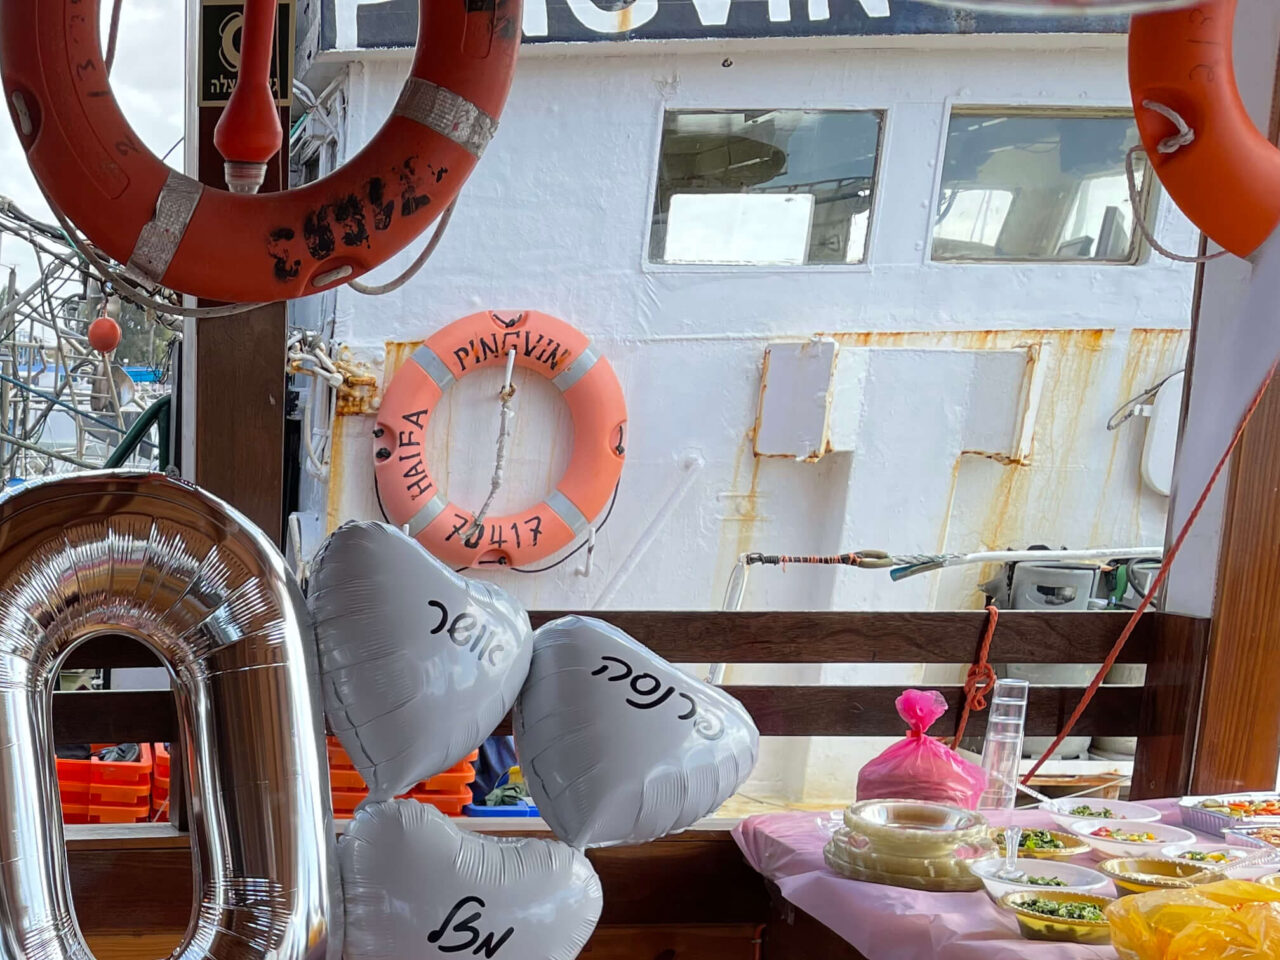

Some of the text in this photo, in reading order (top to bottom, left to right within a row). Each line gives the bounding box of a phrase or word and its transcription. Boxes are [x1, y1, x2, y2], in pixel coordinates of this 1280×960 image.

[210, 74, 236, 94] צלה
[453, 331, 571, 371] PINGVIN
[398, 408, 433, 500] HAIFA
[444, 513, 543, 549] 70417
[591, 656, 725, 741] פרנסה
